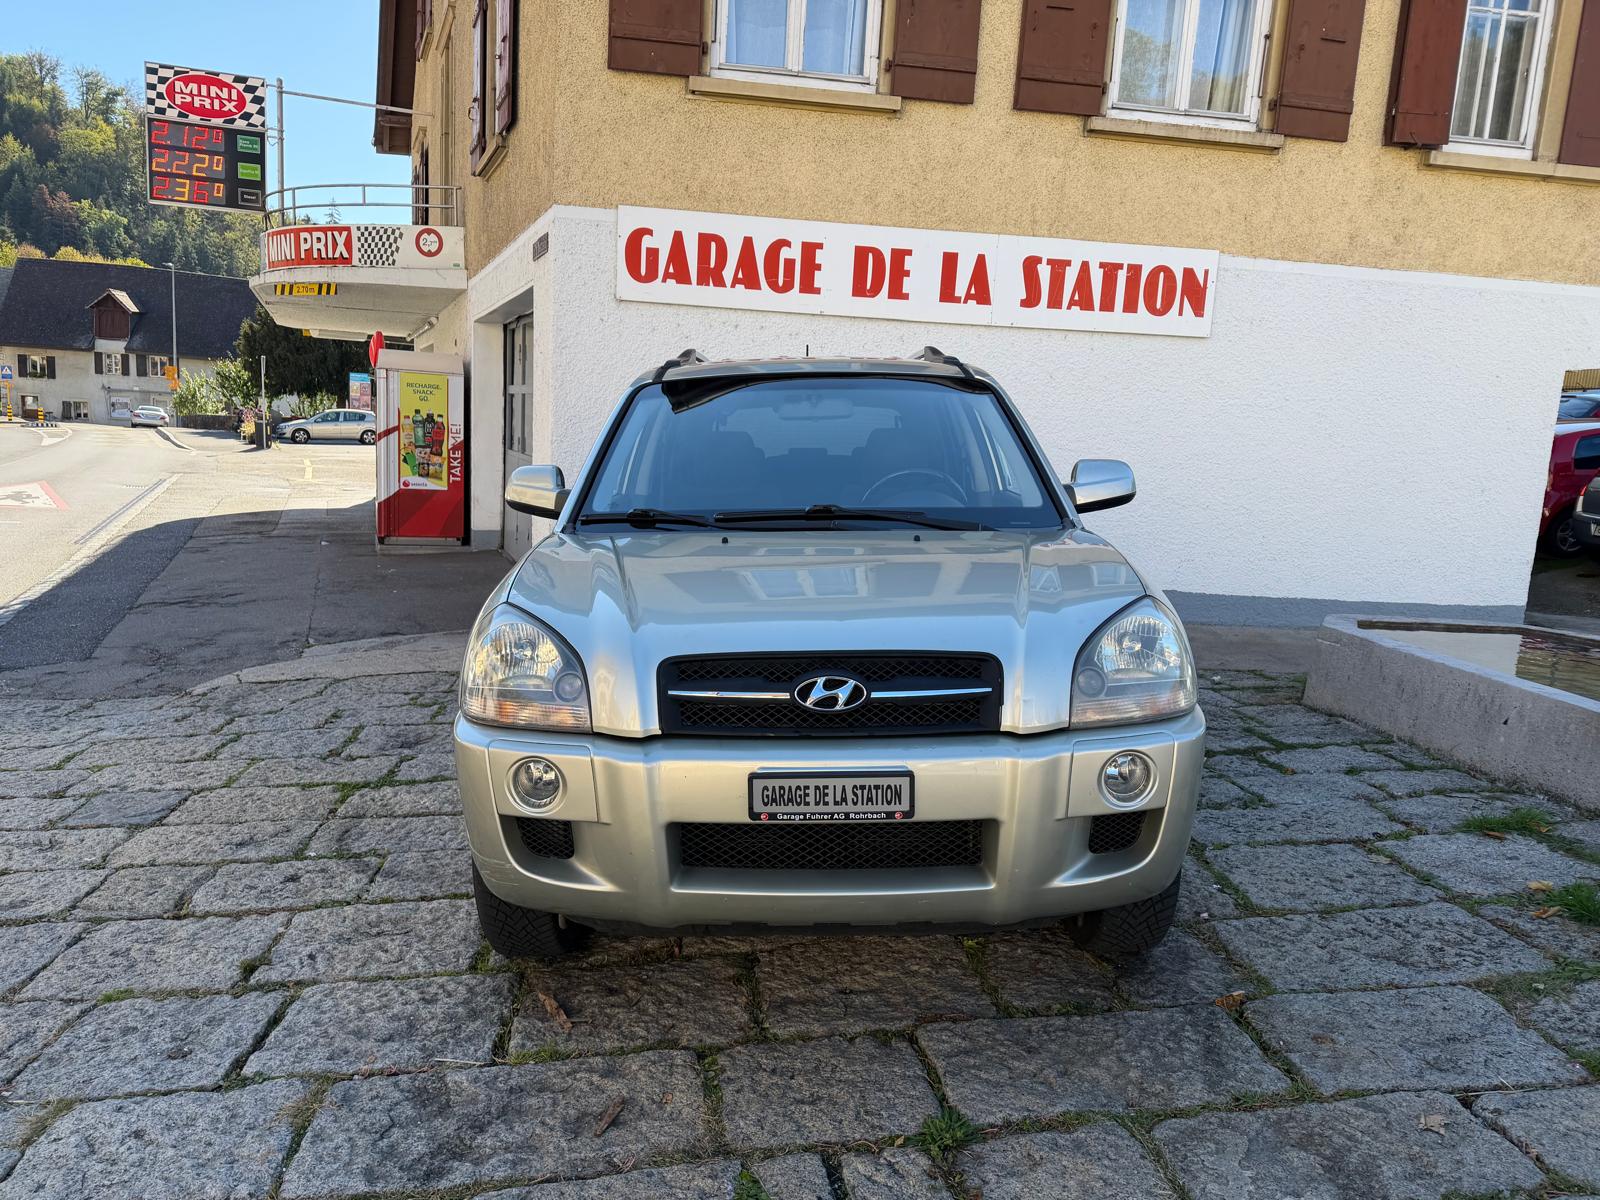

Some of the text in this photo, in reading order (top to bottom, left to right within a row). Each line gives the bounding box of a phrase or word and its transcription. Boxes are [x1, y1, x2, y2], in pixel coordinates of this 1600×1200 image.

[174, 80, 238, 100] MINI
[174, 94, 238, 112] PRIX
[268, 230, 350, 262] MINI PRIX
[624, 226, 1210, 318] GARAGE DE LA STATION
[450, 424, 461, 483] TAKE ME!
[761, 784, 902, 807] GARAGE DE LA STATION
